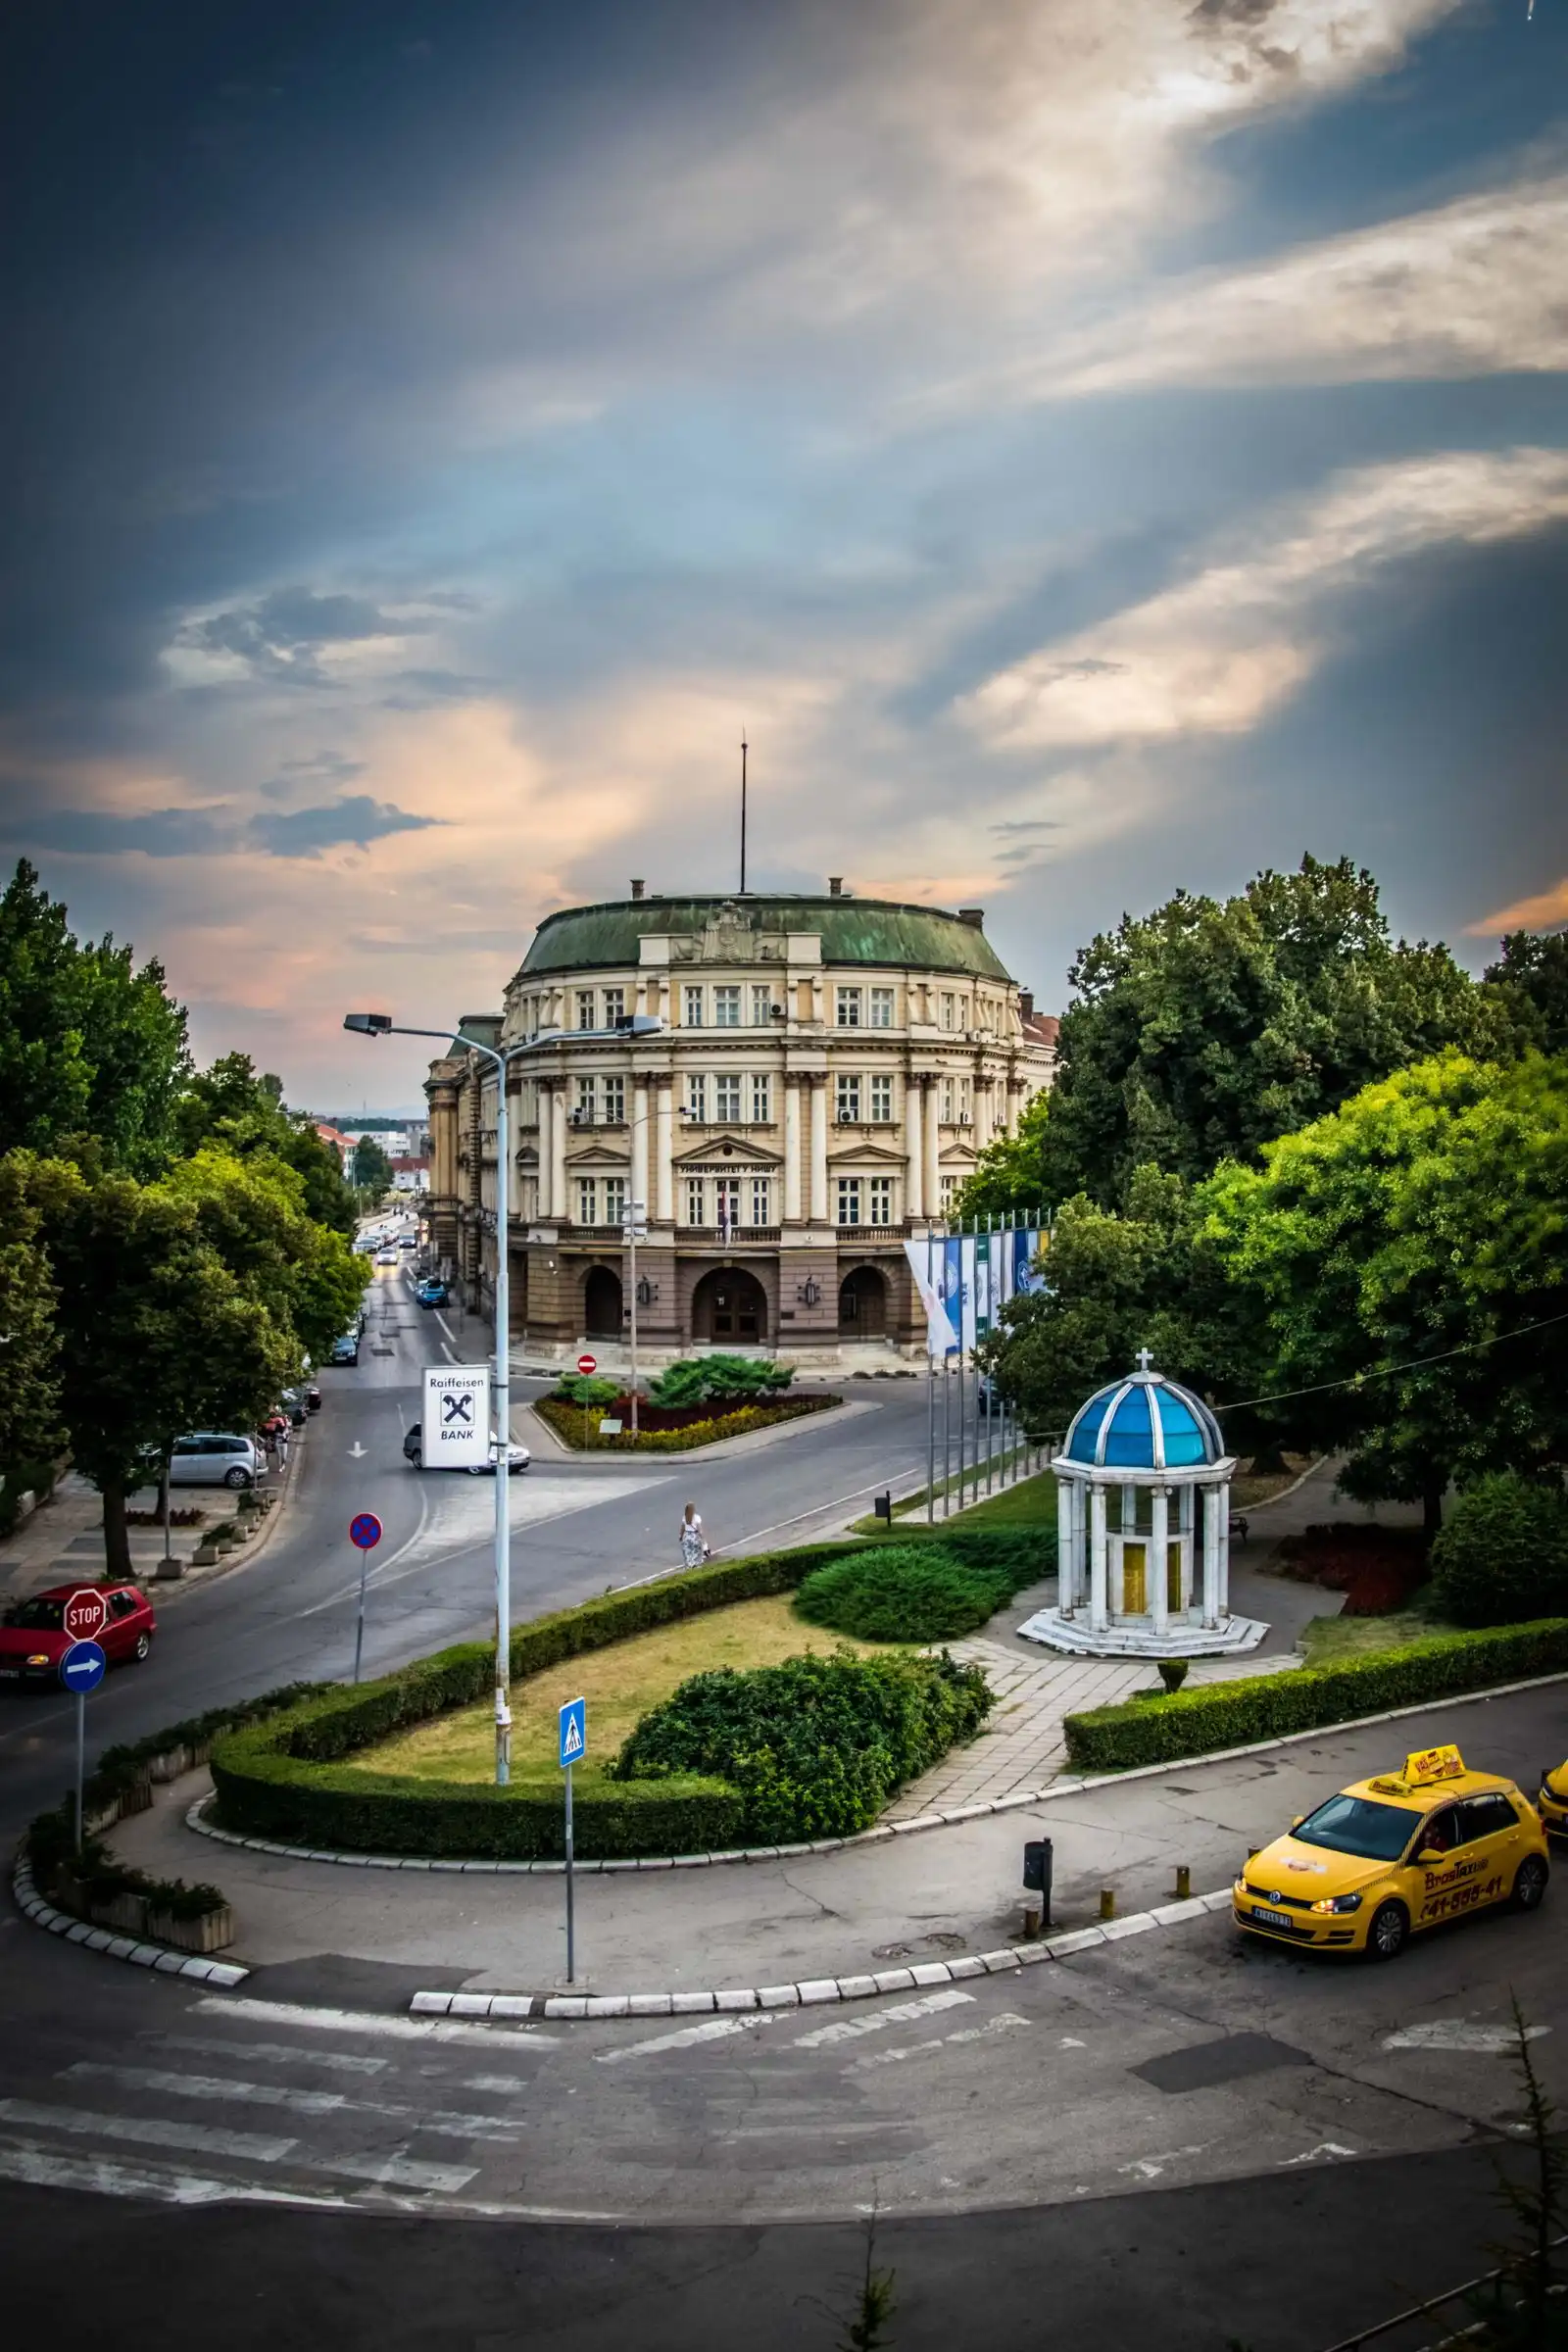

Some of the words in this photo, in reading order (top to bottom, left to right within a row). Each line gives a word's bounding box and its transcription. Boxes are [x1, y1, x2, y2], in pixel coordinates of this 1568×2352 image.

[429, 1377, 484, 1388] Raiffeisen
[441, 1430, 474, 1441] BANK
[70, 1605, 101, 1627] STOP
